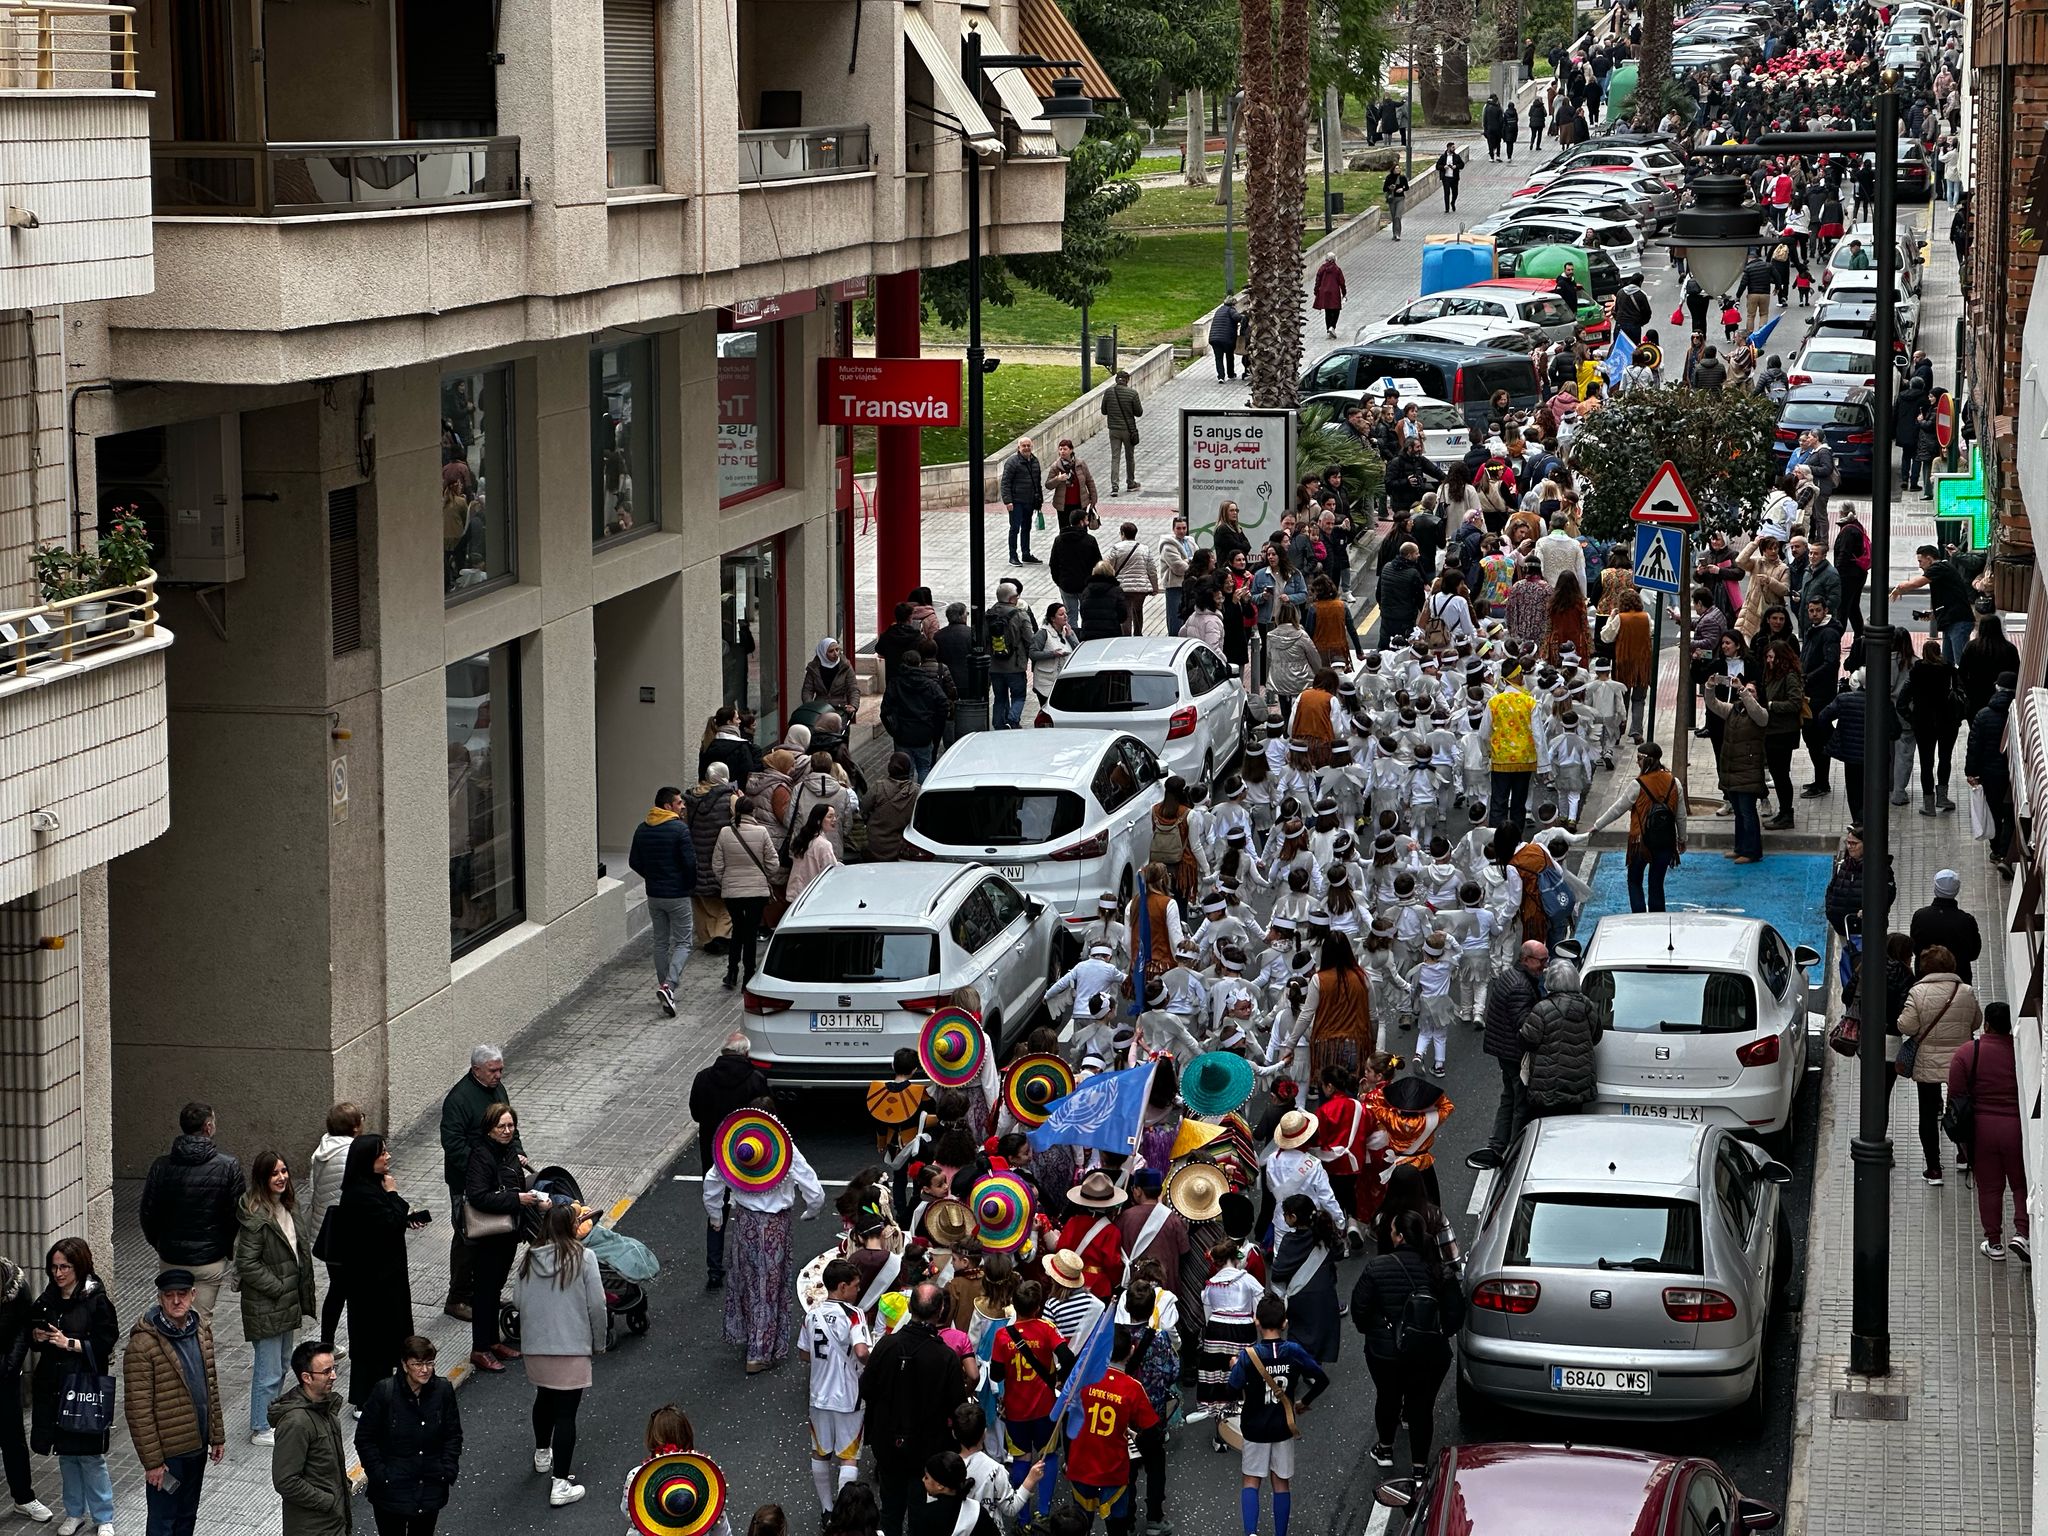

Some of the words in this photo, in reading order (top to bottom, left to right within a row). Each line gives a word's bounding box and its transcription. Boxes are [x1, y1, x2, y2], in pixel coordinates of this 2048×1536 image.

[855, 373, 878, 381] viajes.
[839, 395, 949, 419] Transvia
[1193, 425, 1203, 438] 5
[1206, 427, 1242, 441] anys
[1245, 426, 1264, 438] de
[1193, 456, 1211, 469] és
[820, 1014, 850, 1027] 0311
[856, 1014, 879, 1027] KRL
[1632, 1105, 1667, 1118] 0459
[1673, 1107, 1698, 1120] JLX
[813, 1328, 829, 1360] 2
[1565, 1371, 1606, 1388] 6840
[1616, 1373, 1646, 1389] CWS
[1088, 1402, 1117, 1437] 19
